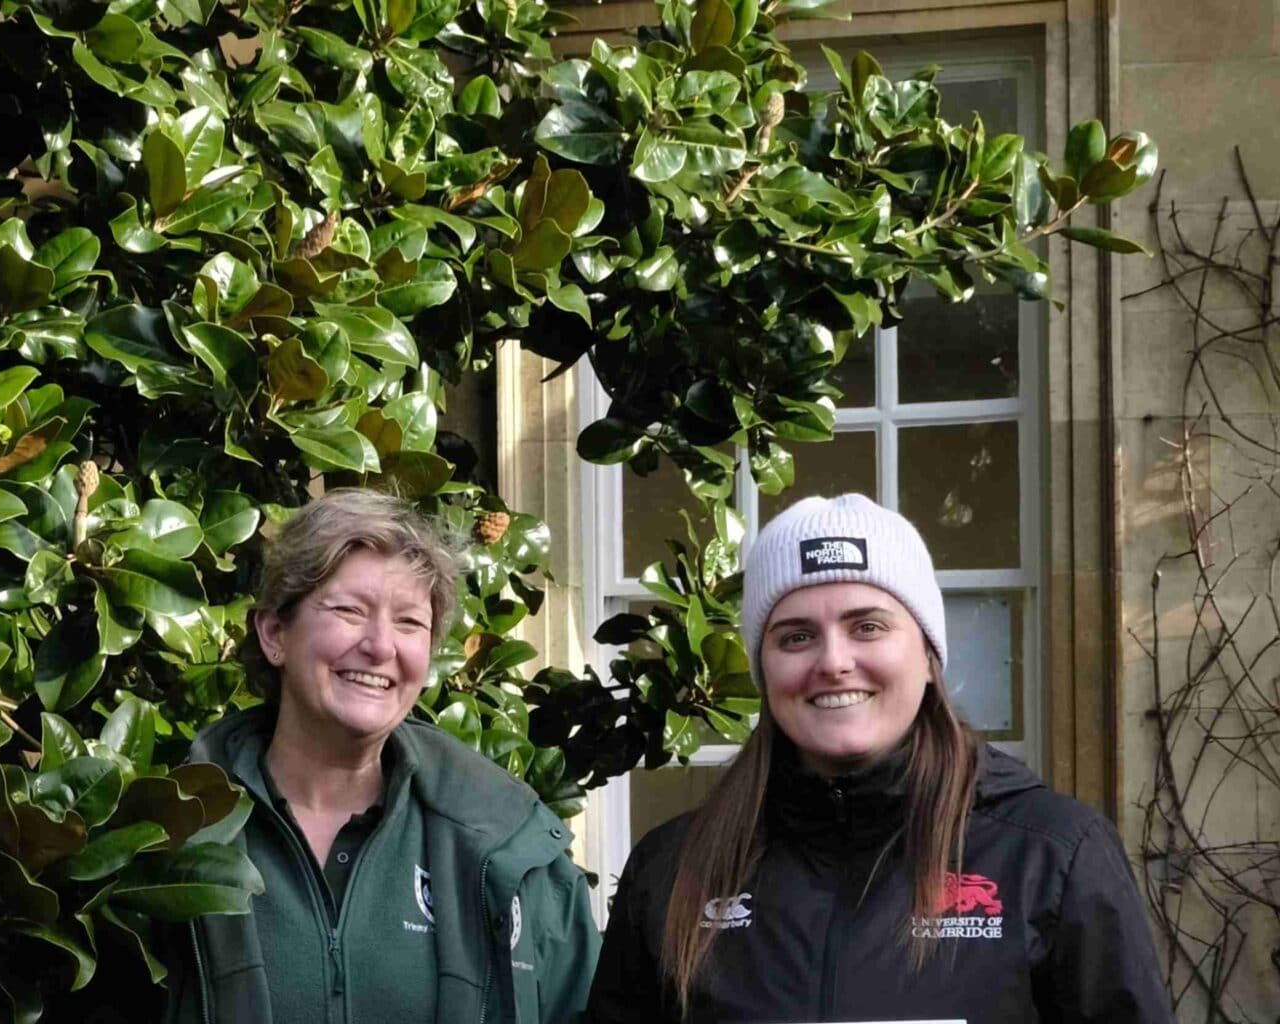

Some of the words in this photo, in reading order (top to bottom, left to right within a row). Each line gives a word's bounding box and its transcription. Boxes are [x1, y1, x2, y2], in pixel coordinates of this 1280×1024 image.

[806, 549, 843, 559] NORTH
[817, 556, 842, 564] FACE
[987, 917, 1003, 926] OF
